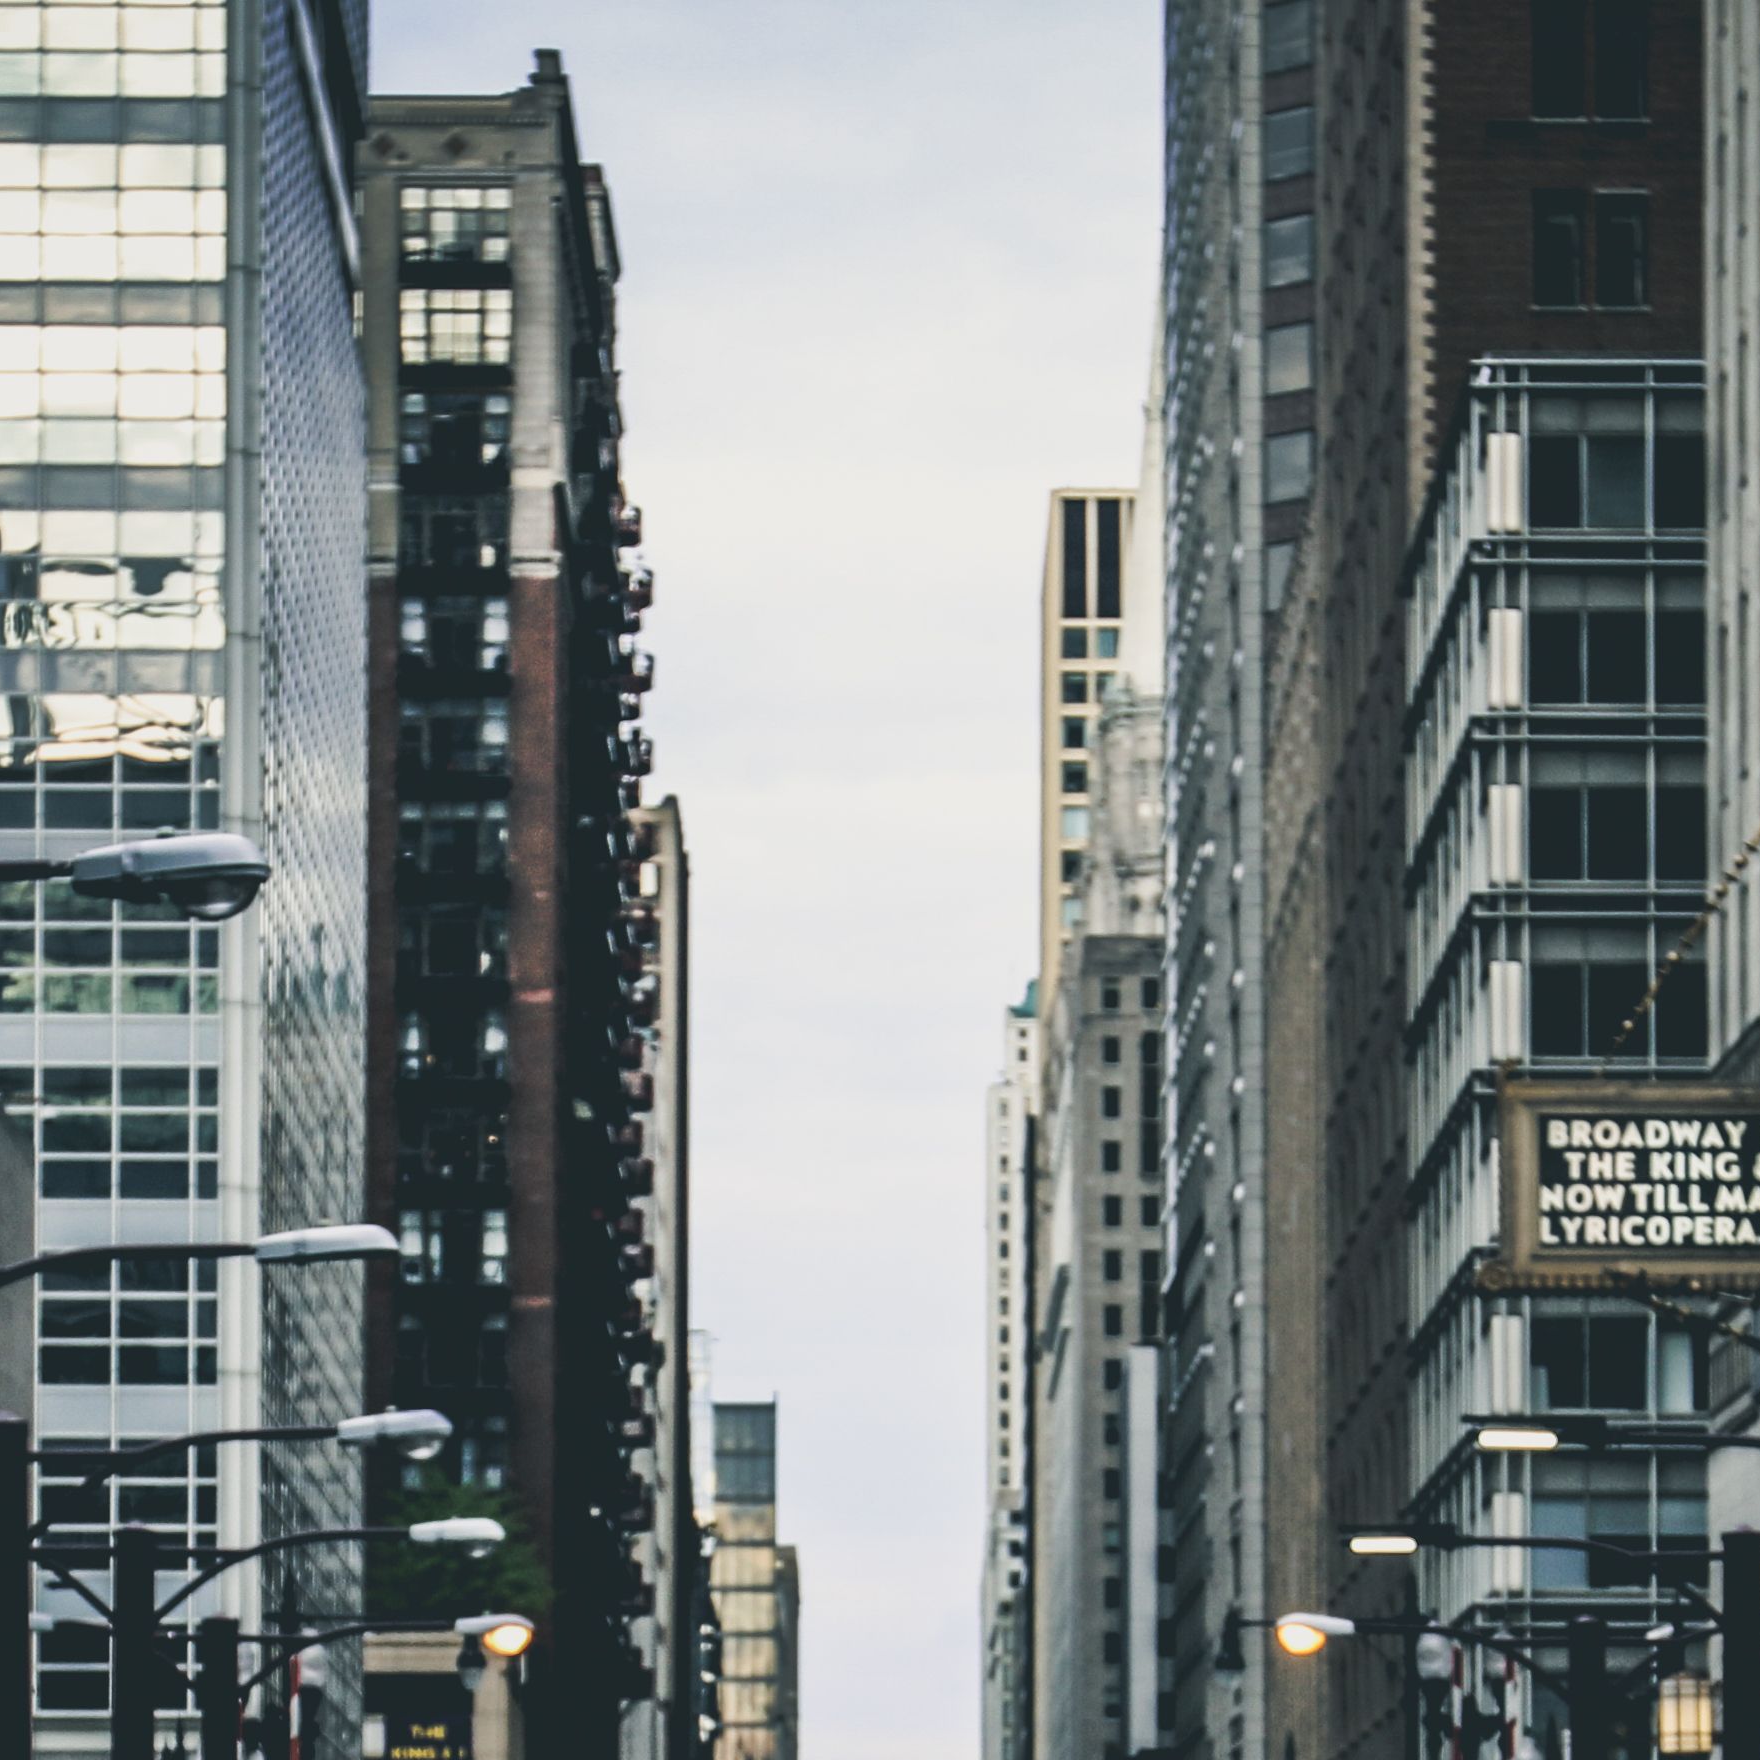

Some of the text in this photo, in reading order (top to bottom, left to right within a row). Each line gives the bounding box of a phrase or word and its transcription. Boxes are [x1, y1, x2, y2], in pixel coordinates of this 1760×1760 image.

[1546, 1119, 1747, 1149] BROADWAY
[1563, 1151, 1636, 1181] THE
[1649, 1151, 1741, 1181] KING
[1540, 1183, 1626, 1212] NOW
[1629, 1183, 1710, 1213] TILL
